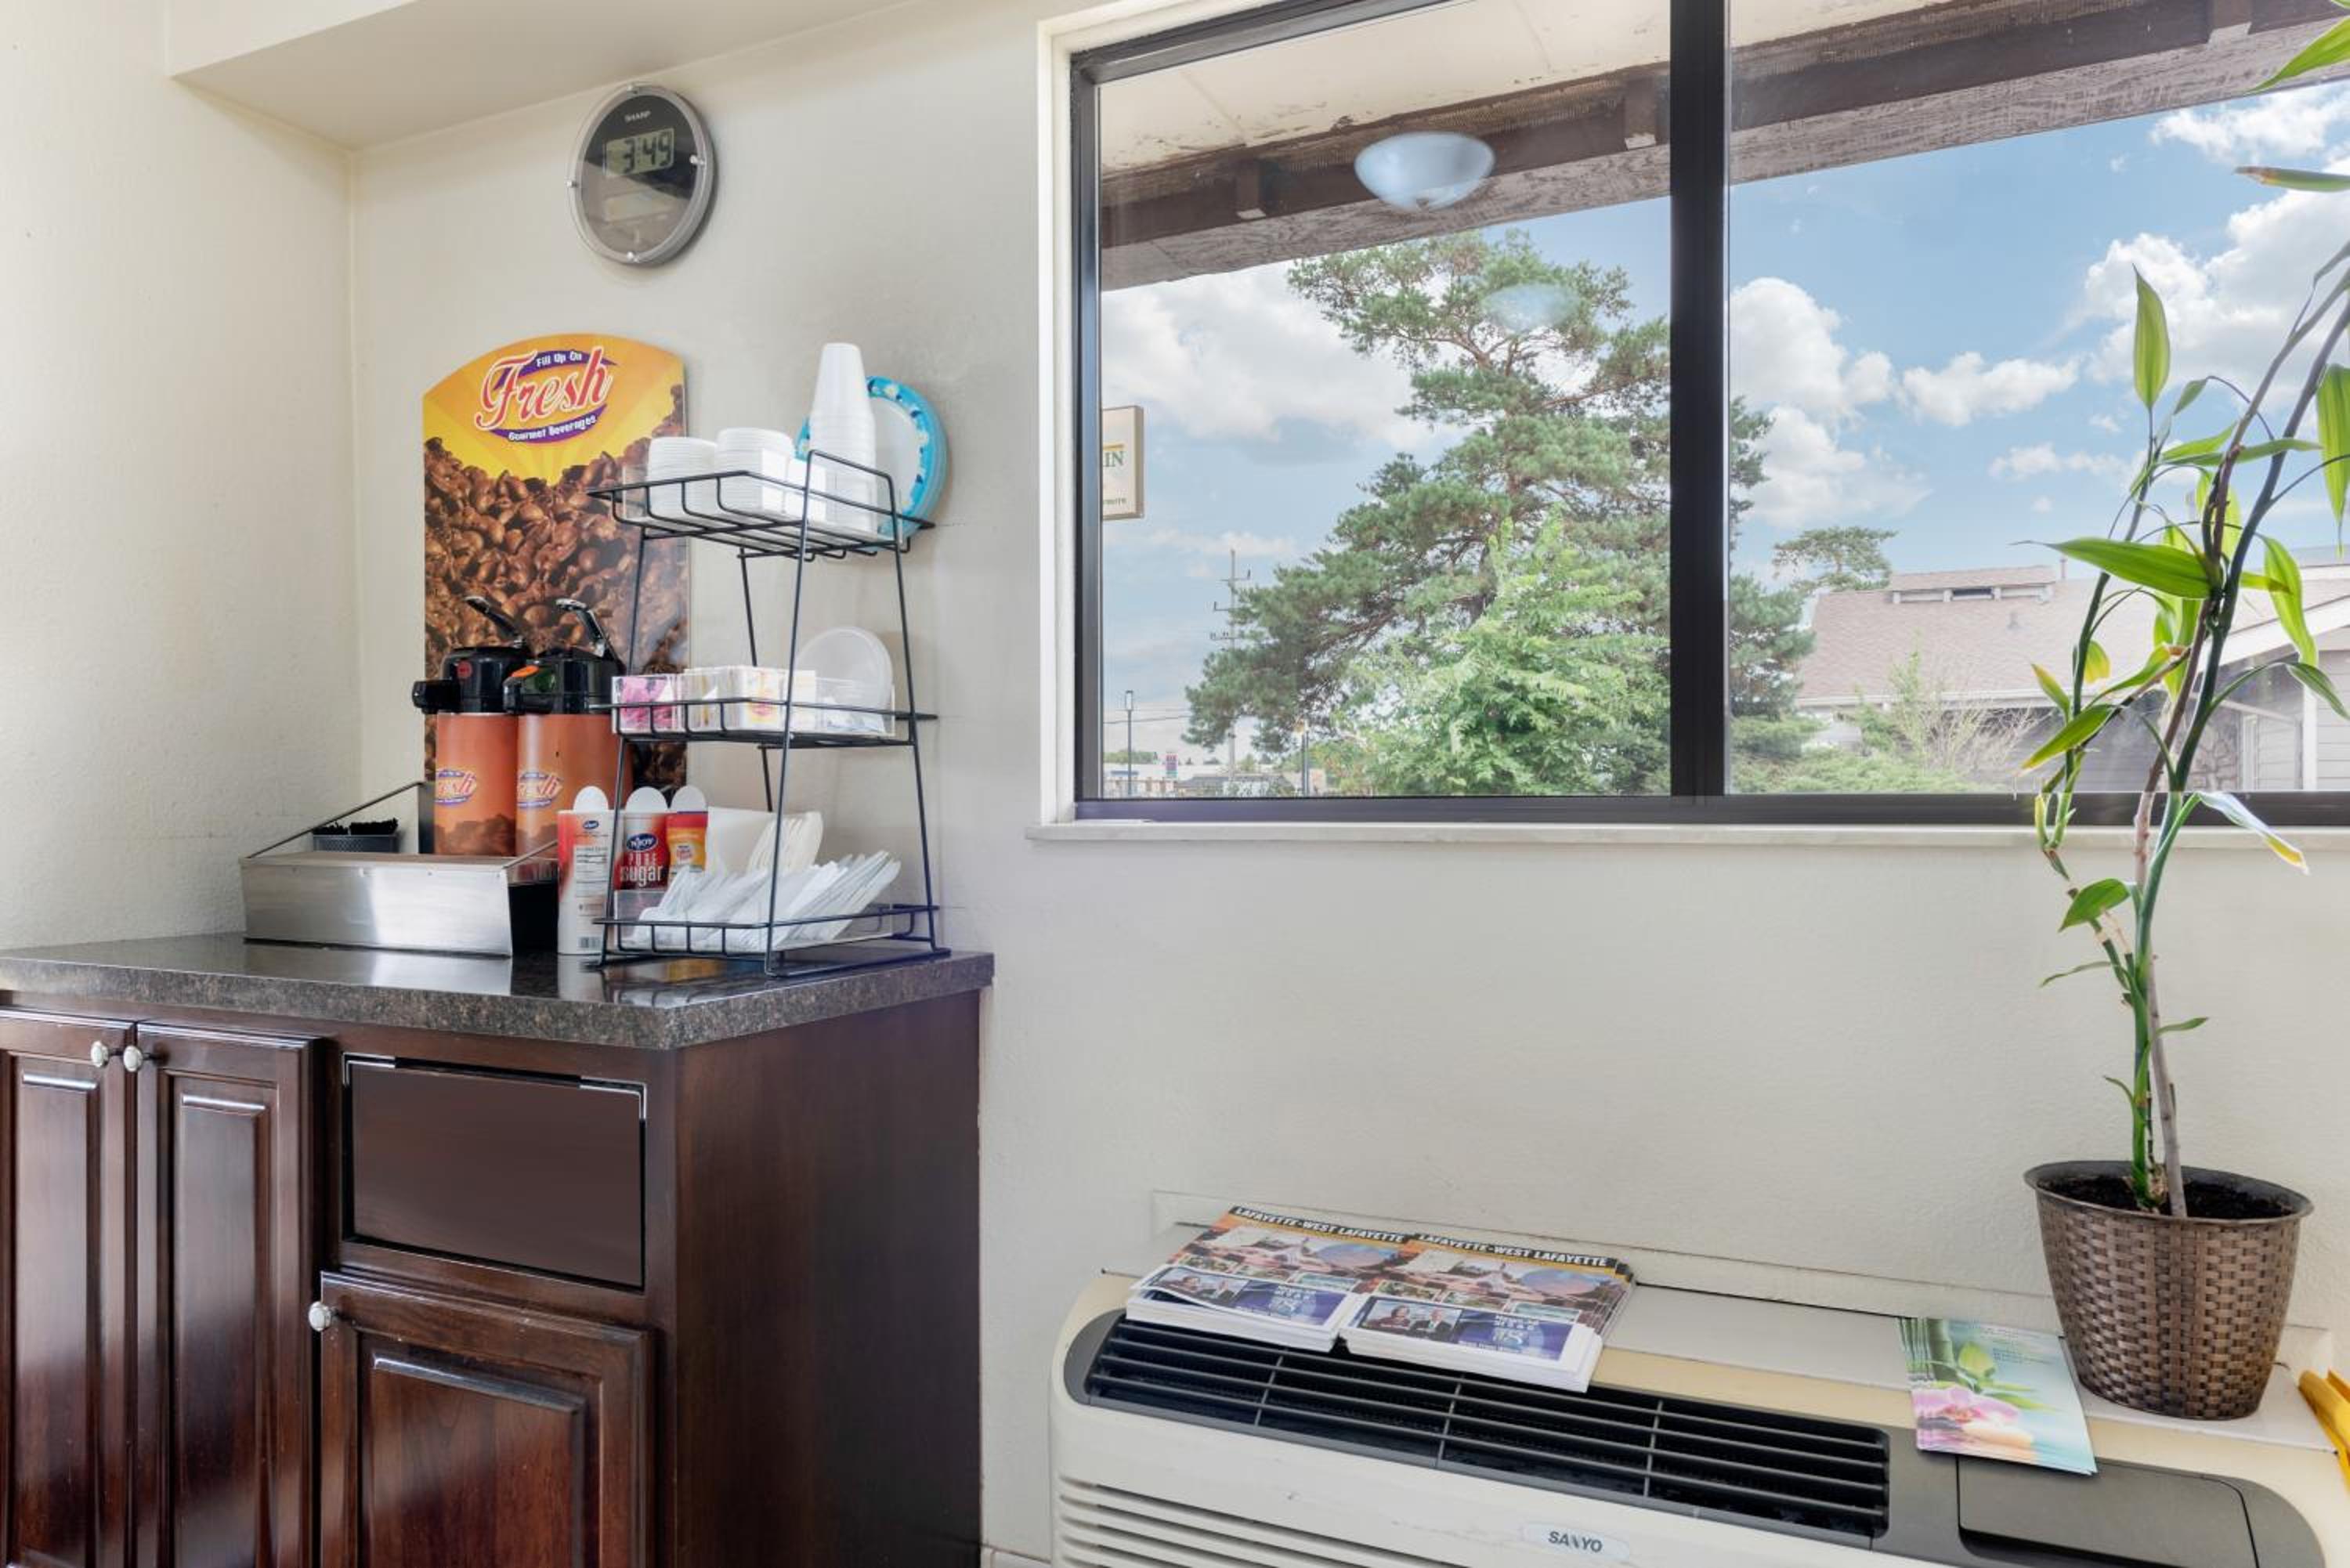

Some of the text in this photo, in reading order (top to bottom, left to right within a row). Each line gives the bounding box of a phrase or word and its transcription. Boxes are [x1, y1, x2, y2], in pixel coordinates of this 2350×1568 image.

[624, 110, 651, 122] SHARP
[624, 132, 672, 173] 3:49
[537, 351, 582, 367] Fill Up On
[475, 346, 614, 432] Fresh
[509, 415, 596, 441] Gourmet Beverages
[628, 852, 657, 865] PURE
[620, 865, 663, 887] sugar
[1235, 1206, 1405, 1243] LAFAYETTE-WEST LAFAYETTE
[1419, 1234, 1607, 1266] LAFAYETTE-WEST LAFAYETTE
[1548, 1530, 1603, 1552] SANYO
